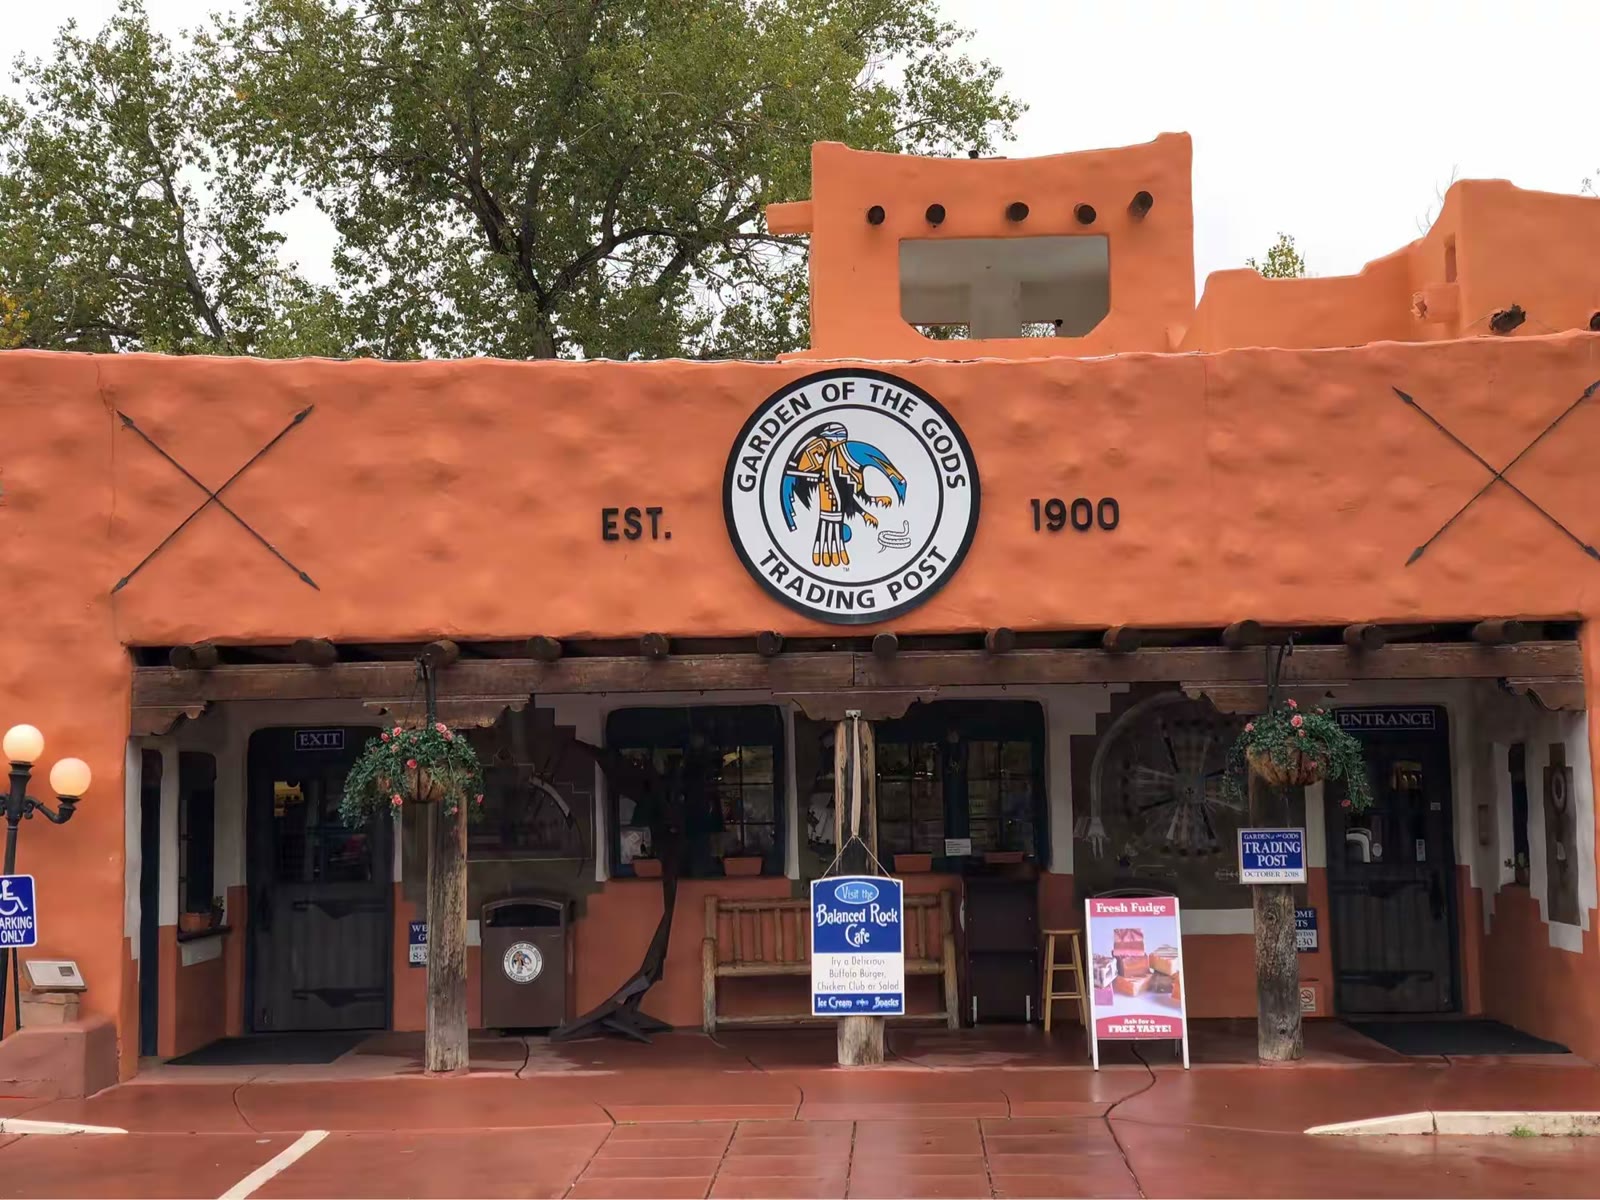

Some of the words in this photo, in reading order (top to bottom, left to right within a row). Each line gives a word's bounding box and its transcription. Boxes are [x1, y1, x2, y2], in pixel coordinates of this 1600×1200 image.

[737, 392, 812, 493] GARDEN
[821, 381, 855, 403] OF
[869, 383, 918, 419] THE
[921, 418, 966, 489] GODS
[1030, 497, 1120, 532] 1900
[602, 506, 672, 540] EST.
[759, 549, 875, 610] TRADING
[886, 545, 948, 602] POST
[1340, 712, 1431, 726] ENTRANCE
[299, 732, 340, 746] EXIT
[1243, 841, 1301, 854] TRADING
[1257, 854, 1288, 867] POST
[841, 886, 859, 900] Visit
[862, 889, 873, 900] the
[816, 903, 866, 927] Balanced
[870, 903, 898, 927] Rock
[1096, 902, 1128, 913] Fresh
[1131, 902, 1166, 915] Fudge
[0, 916, 33, 930] ARKING
[0, 929, 26, 943] ONLY
[845, 923, 870, 948] Cafe
[831, 956, 841, 967] Try
[851, 955, 885, 966] Delicious
[829, 969, 857, 978] Buffalo
[859, 969, 887, 979] Burger,
[817, 981, 846, 991] Chicken
[848, 981, 865, 991] Club
[868, 982, 876, 991] or
[879, 980, 899, 991] Salad
[817, 996, 827, 1008] Ice
[828, 996, 852, 1009] Cream
[872, 996, 899, 1010] Snacks
[1108, 1025, 1136, 1033] FREE
[1136, 1025, 1171, 1033] TASTE!
